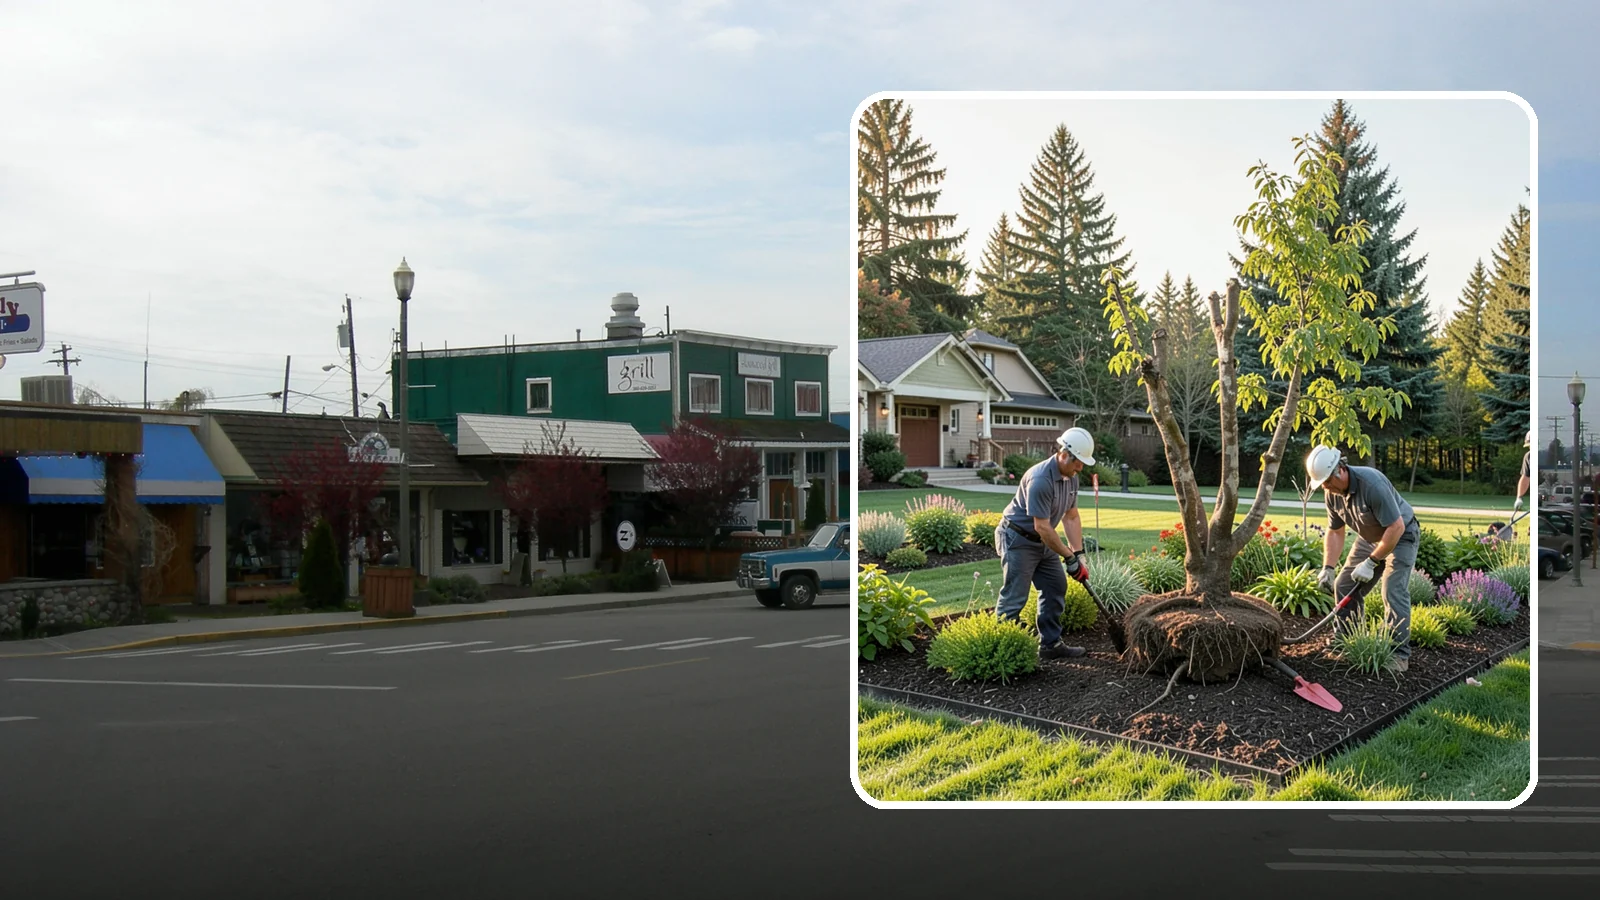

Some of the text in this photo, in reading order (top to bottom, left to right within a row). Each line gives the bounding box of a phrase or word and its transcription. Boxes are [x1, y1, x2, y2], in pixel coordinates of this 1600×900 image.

[0, 297, 19, 324] ly
[19, 337, 37, 345] Salads
[617, 356, 655, 391] grill
